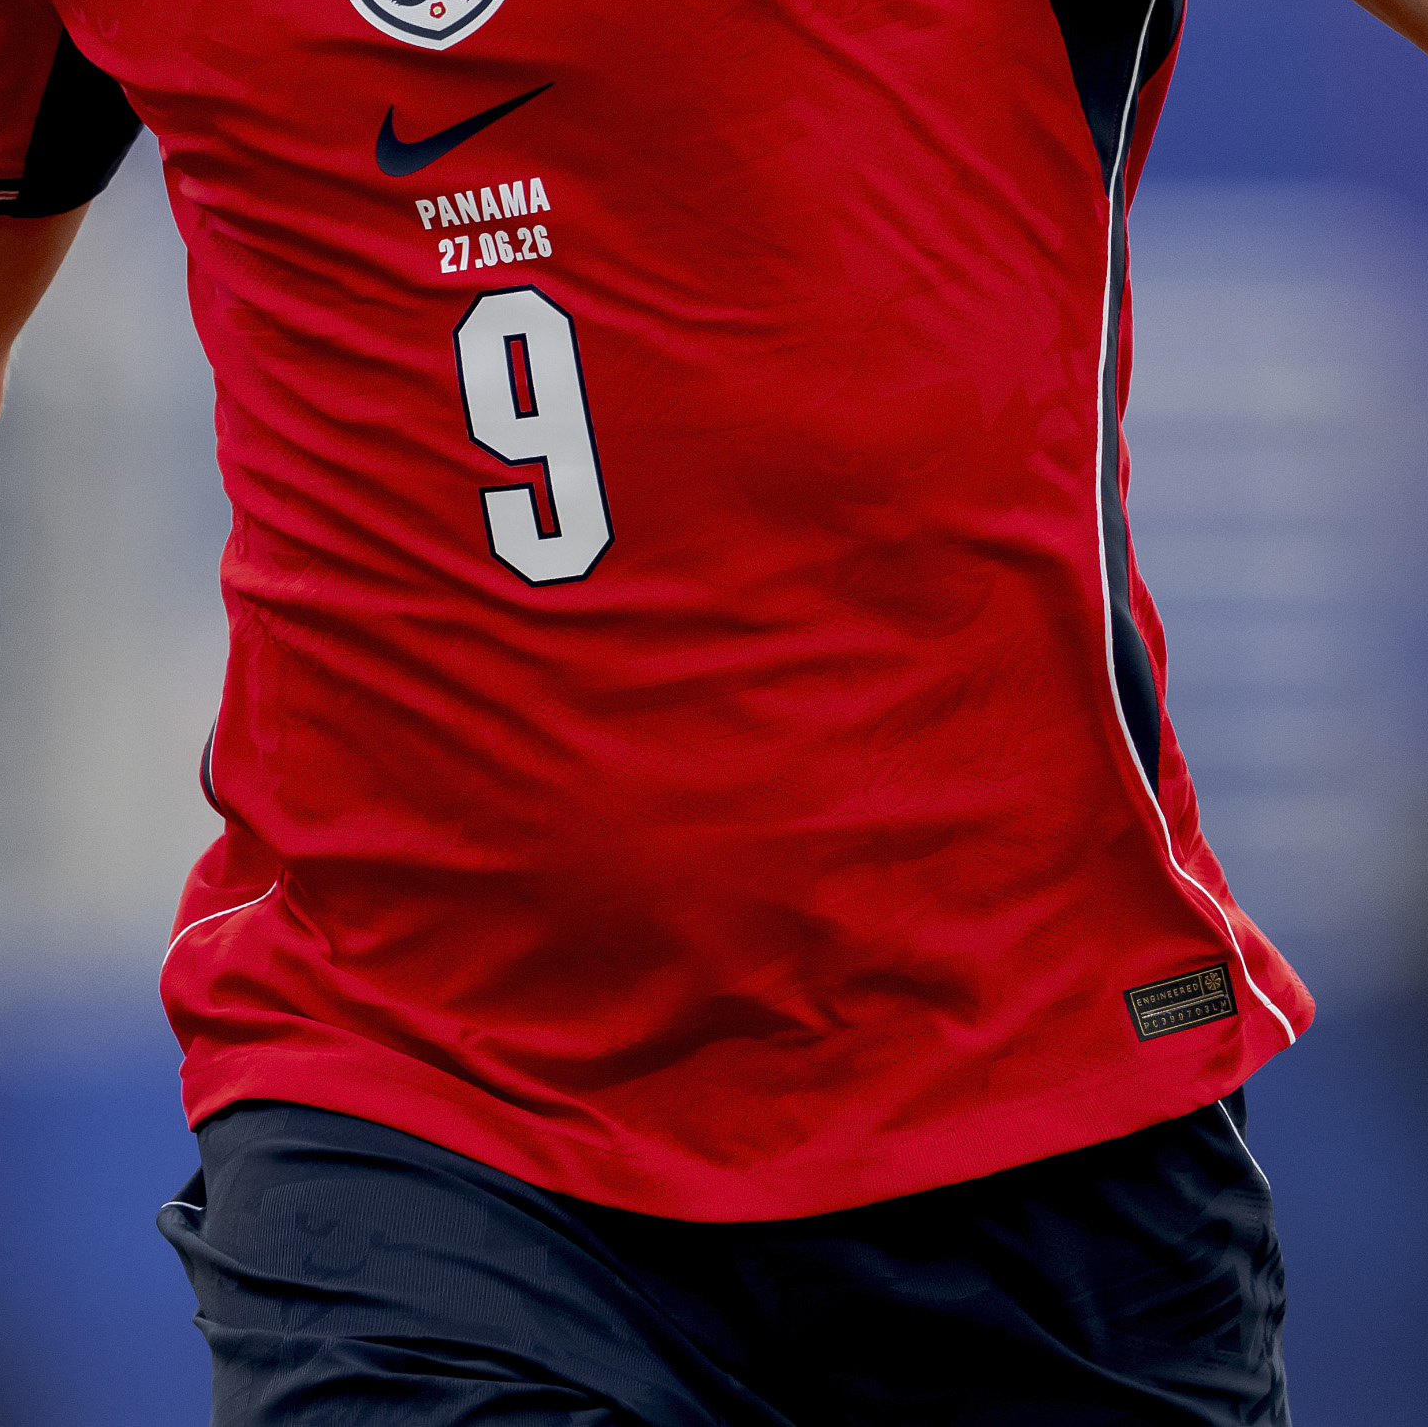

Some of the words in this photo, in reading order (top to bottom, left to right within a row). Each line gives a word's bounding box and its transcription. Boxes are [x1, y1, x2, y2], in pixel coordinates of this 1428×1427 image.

[415, 177, 552, 230] PANAMA
[438, 224, 553, 274] 27.06.26
[452, 283, 615, 587] 9
[1136, 983, 1199, 1007] ENGINEERED
